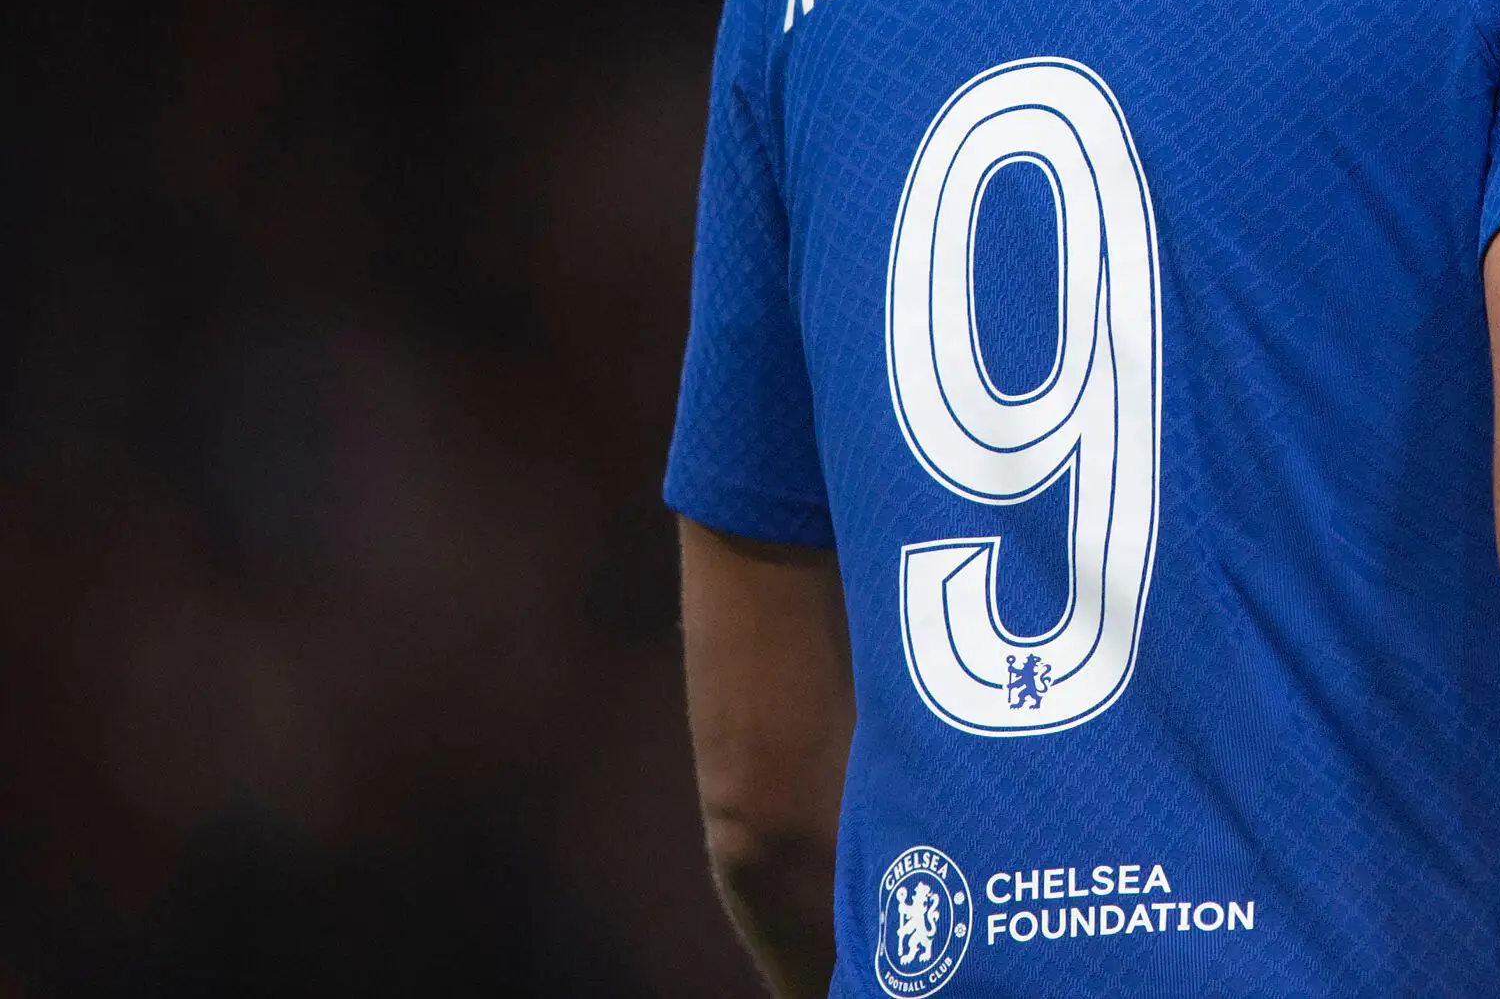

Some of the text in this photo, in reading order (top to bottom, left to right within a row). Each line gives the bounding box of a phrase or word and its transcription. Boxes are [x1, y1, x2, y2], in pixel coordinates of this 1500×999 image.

[885, 56, 1163, 737] 9
[885, 852, 950, 891] CHELSEA
[986, 864, 1172, 904] CHELSEA
[987, 901, 1255, 945] FOUNDATION
[884, 957, 953, 992] FOOTBALL CLUB
